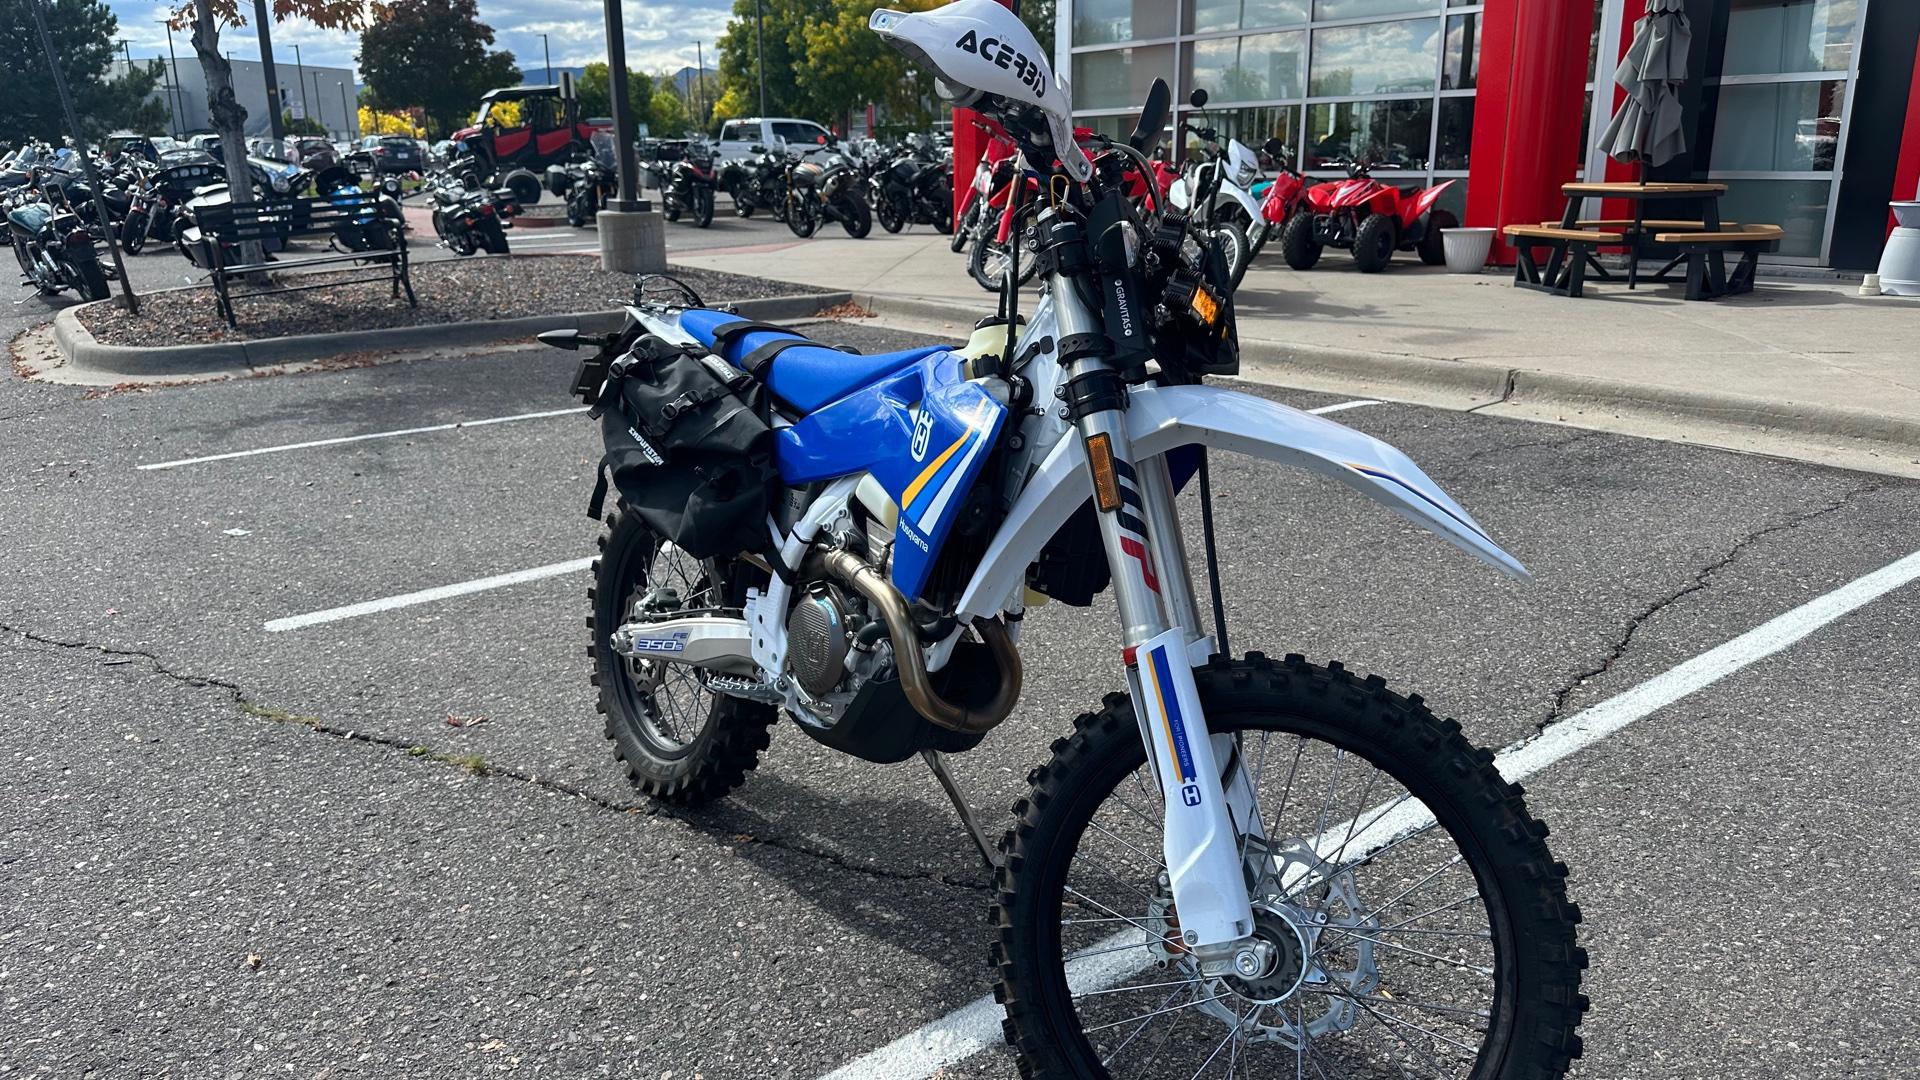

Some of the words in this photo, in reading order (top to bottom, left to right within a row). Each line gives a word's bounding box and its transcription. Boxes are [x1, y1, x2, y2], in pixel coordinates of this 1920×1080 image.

[1116, 286, 1131, 329] GRAVITAS
[899, 516, 929, 552] Husqvarna
[1179, 735, 1190, 767] PIONEERS
